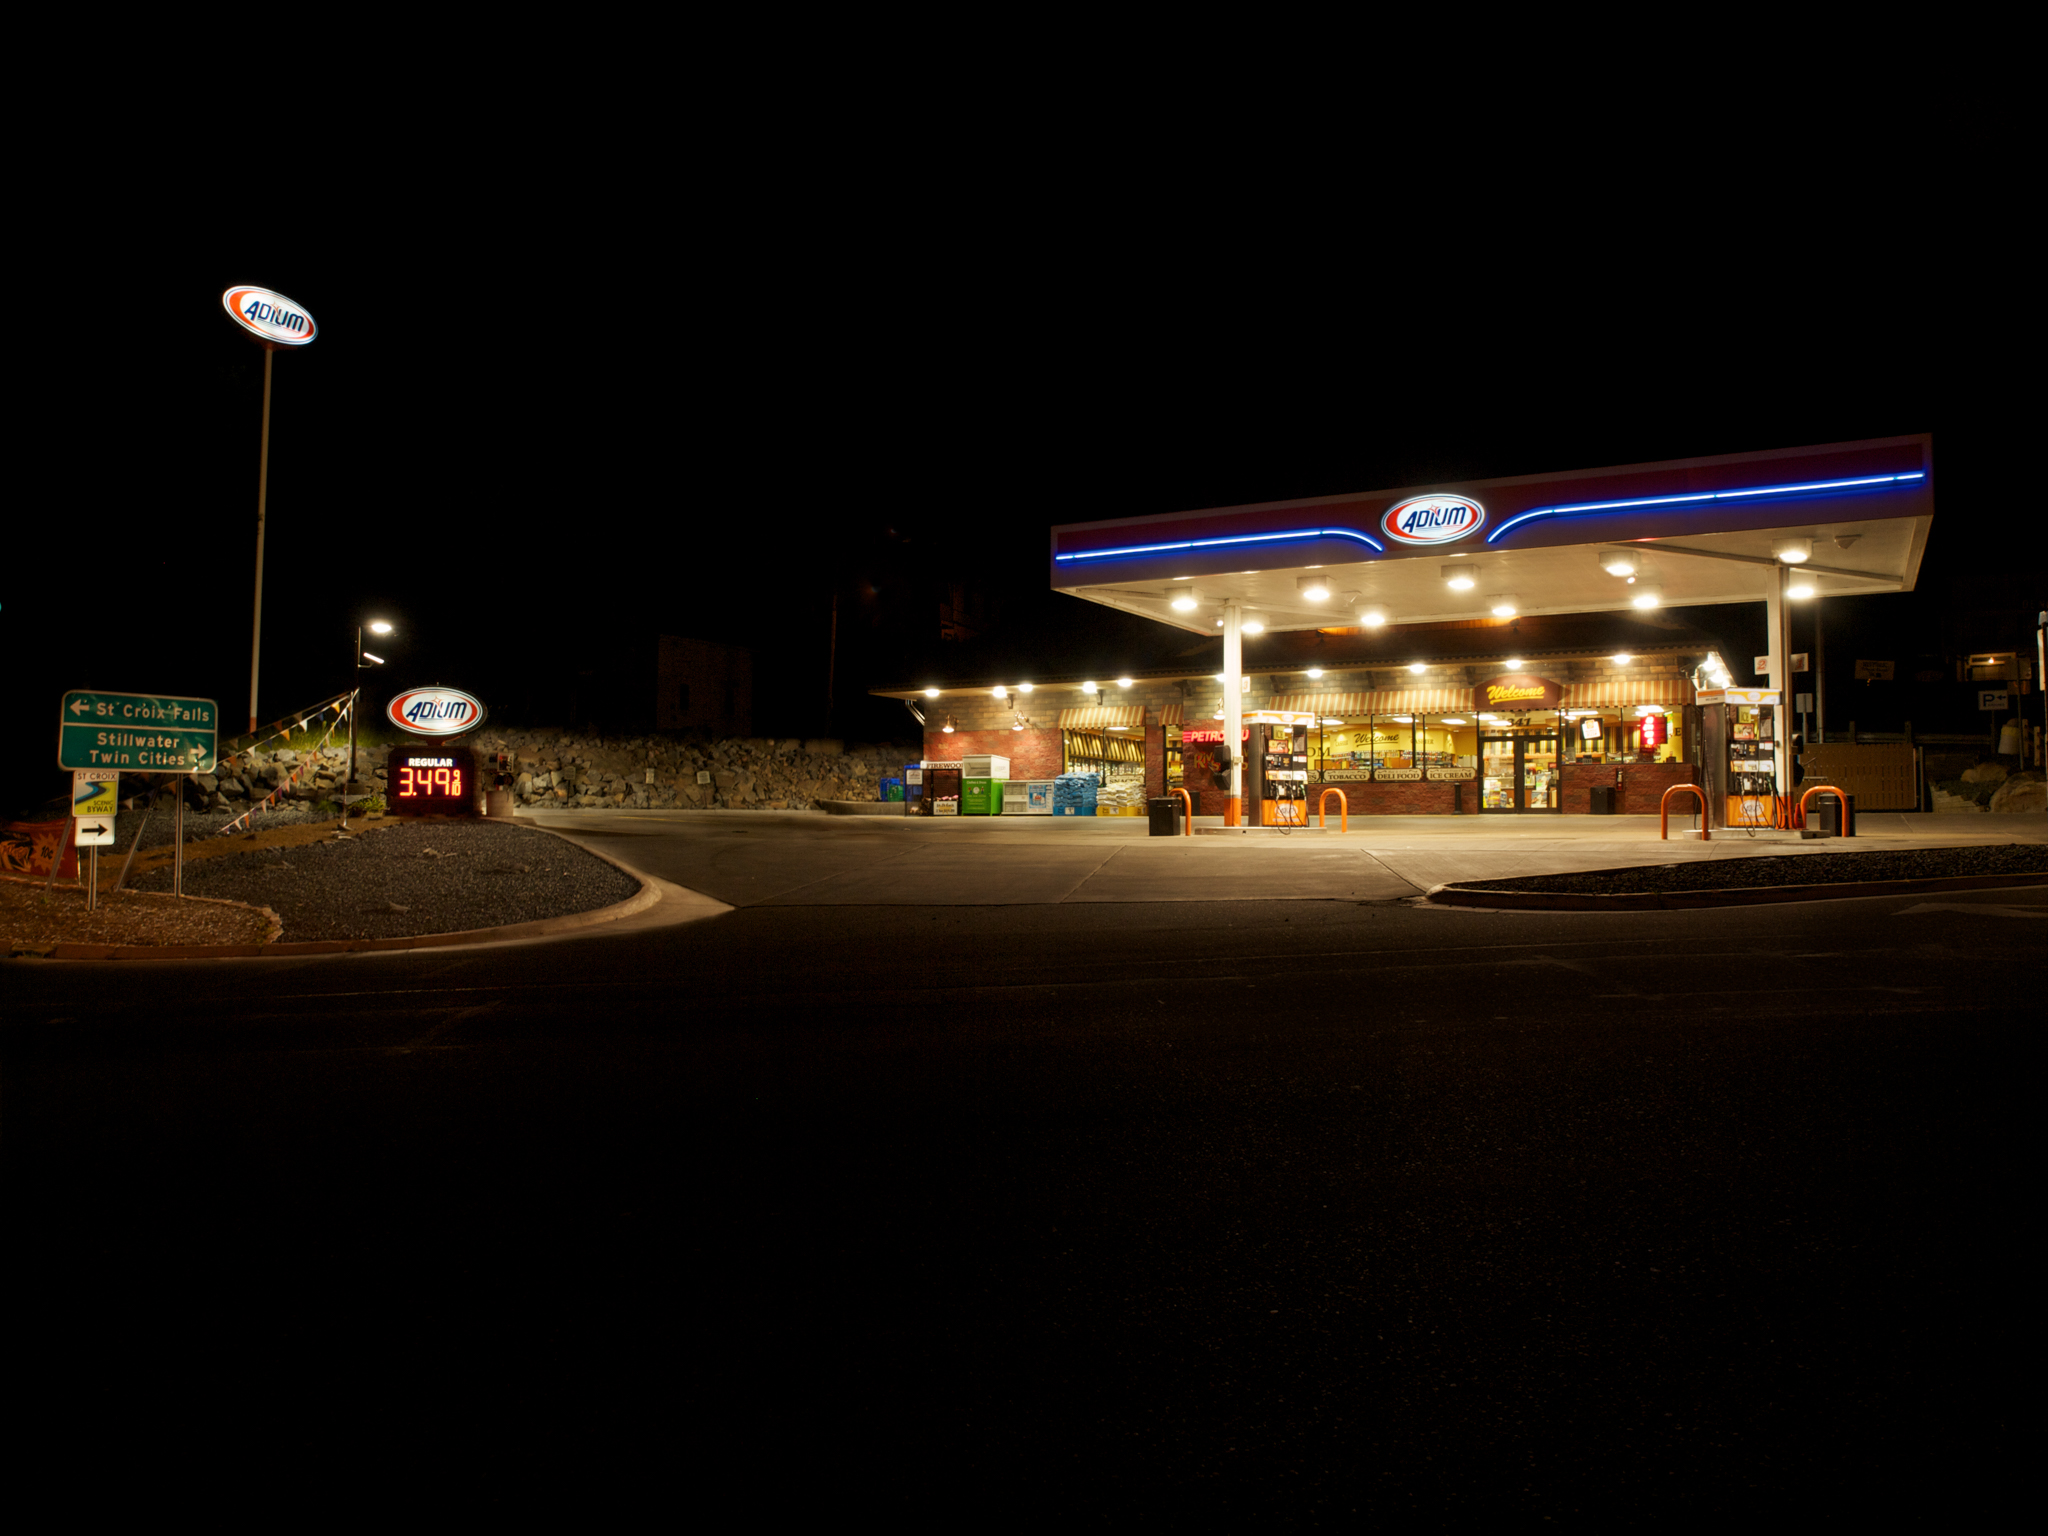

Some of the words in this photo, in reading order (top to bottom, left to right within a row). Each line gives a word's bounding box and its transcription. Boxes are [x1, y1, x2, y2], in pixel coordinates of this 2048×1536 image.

[244, 300, 305, 332] ADIUM
[1402, 506, 1467, 533] ADIUM
[1756, 659, 1767, 670] 2
[1486, 684, 1545, 702] Welcome
[96, 703, 114, 716] St
[123, 704, 165, 719] Croix
[173, 707, 210, 722] Falls
[405, 702, 468, 722] ADIUM
[97, 732, 179, 748] Stillwater
[1354, 732, 1399, 746] Welcome
[90, 750, 129, 763] Twin
[138, 752, 185, 766] Cities
[408, 758, 453, 767] REGULAR
[926, 762, 963, 770] FIREWOO
